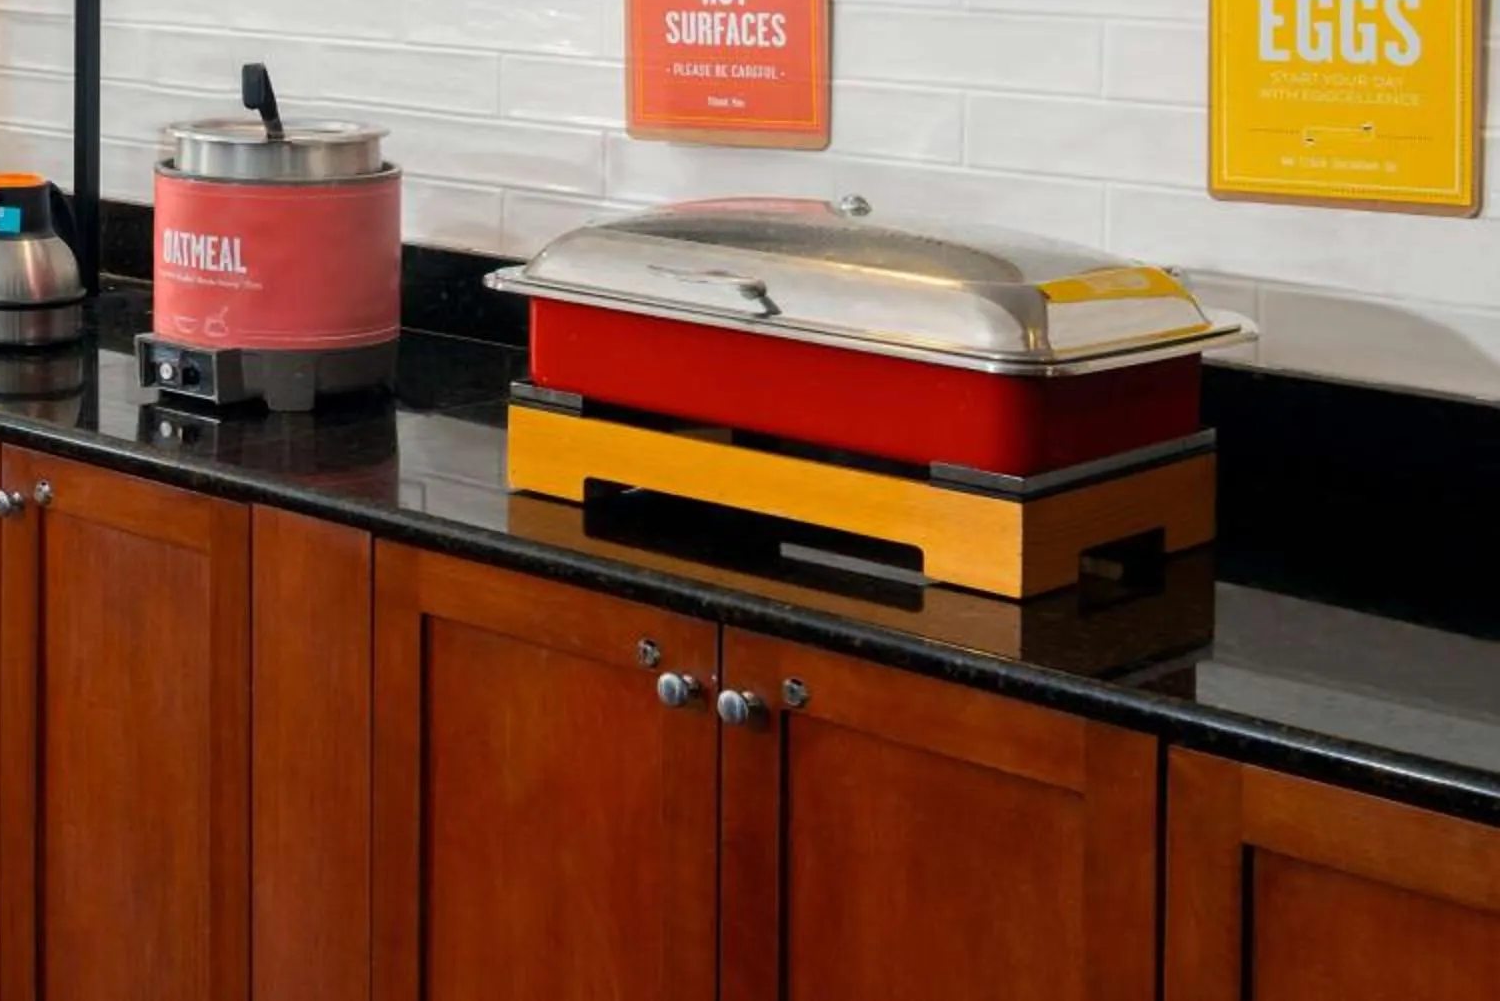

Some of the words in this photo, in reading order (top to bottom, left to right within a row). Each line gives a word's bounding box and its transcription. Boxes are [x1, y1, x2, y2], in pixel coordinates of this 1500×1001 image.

[664, 10, 787, 48] SURFACES
[673, 62, 711, 78] PLEASE
[714, 63, 728, 77] BE
[162, 227, 248, 274] OATMEAL
